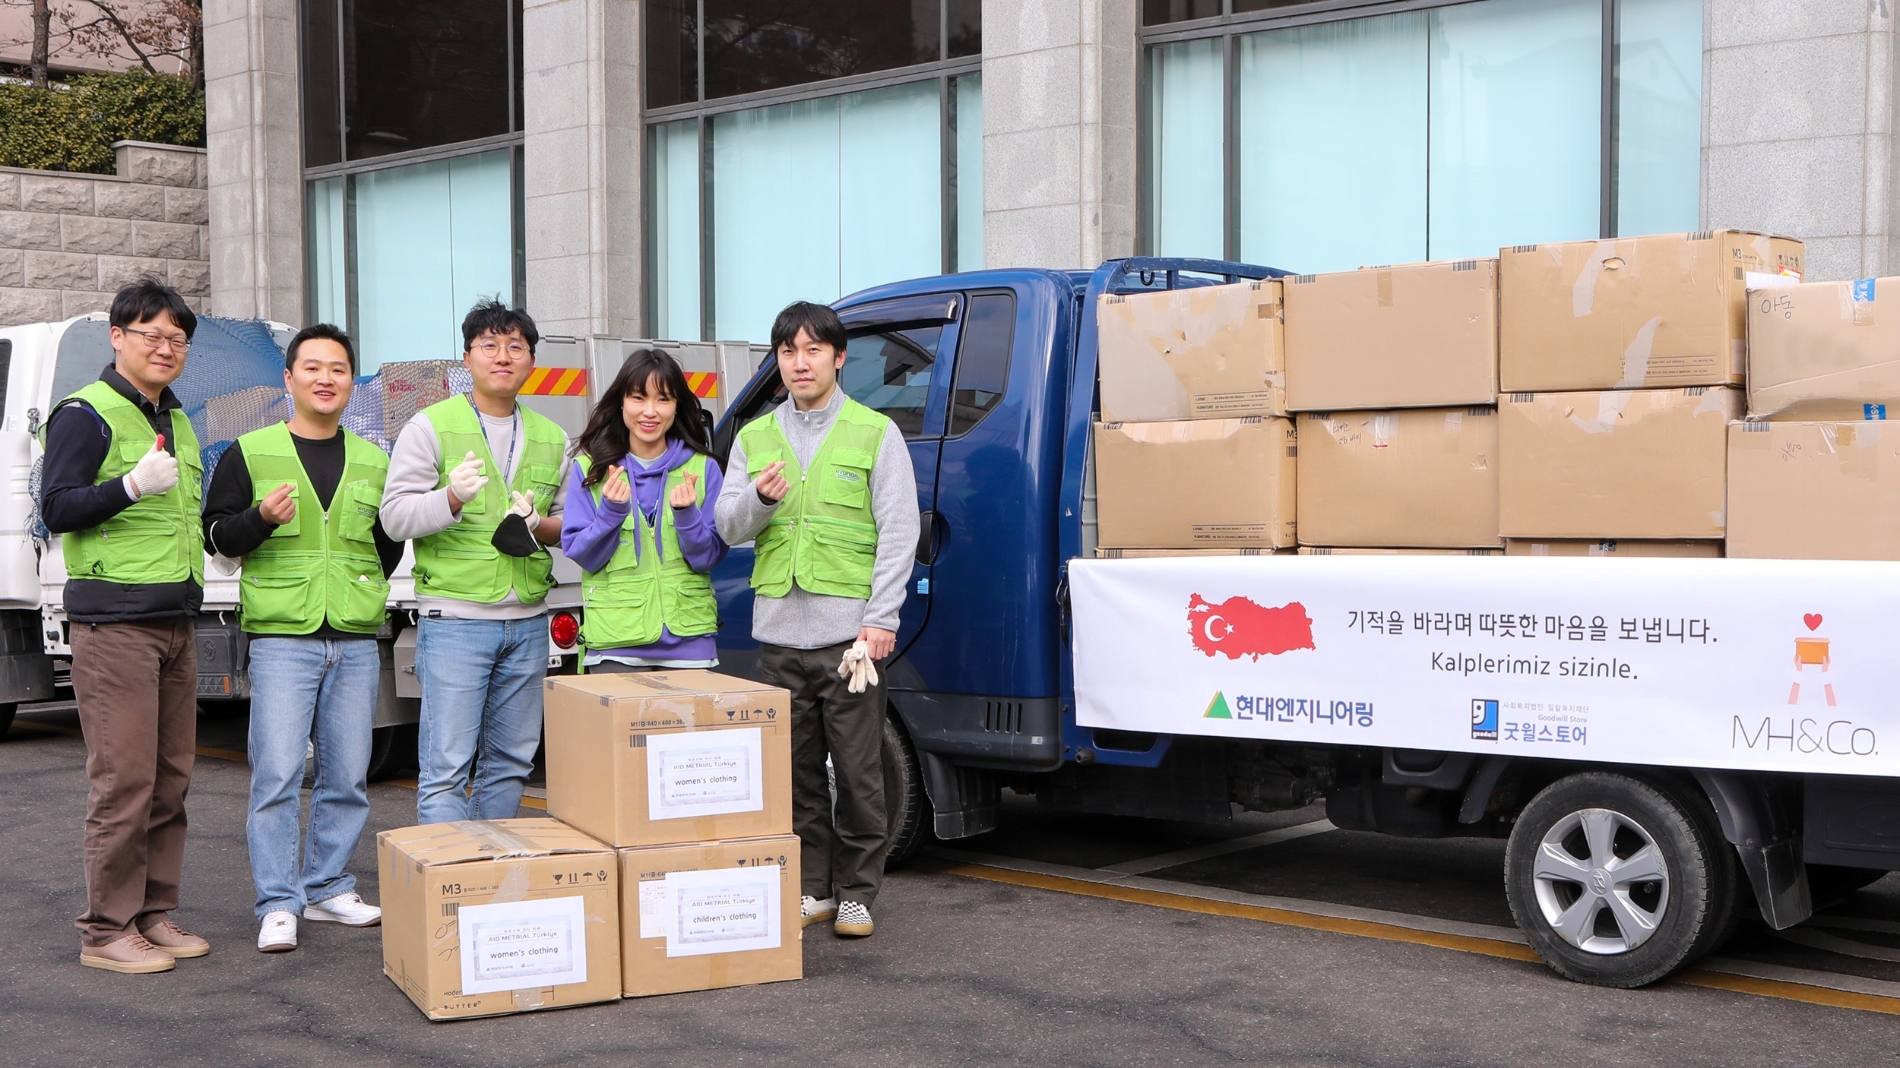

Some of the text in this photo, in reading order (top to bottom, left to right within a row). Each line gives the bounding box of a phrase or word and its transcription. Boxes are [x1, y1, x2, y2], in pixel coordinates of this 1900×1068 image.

[1761, 295, 1796, 319] 아동
[1347, 610, 1718, 644] 기적을 바라며 따뜻한 마음을 보냅니다.
[1431, 652, 1638, 680] Kalplerimiz sizinle.
[1235, 694, 1375, 728] 현대엔지니어링
[1538, 714, 1588, 724] Goodwill Store
[1503, 722, 1588, 746] 굿윌스토어
[1732, 715, 1879, 756] MH&Co.
[675, 775, 738, 786] women's clothing
[442, 883, 462, 896] M3
[693, 912, 757, 924] children's clothing
[490, 946, 559, 960] women's clothing
